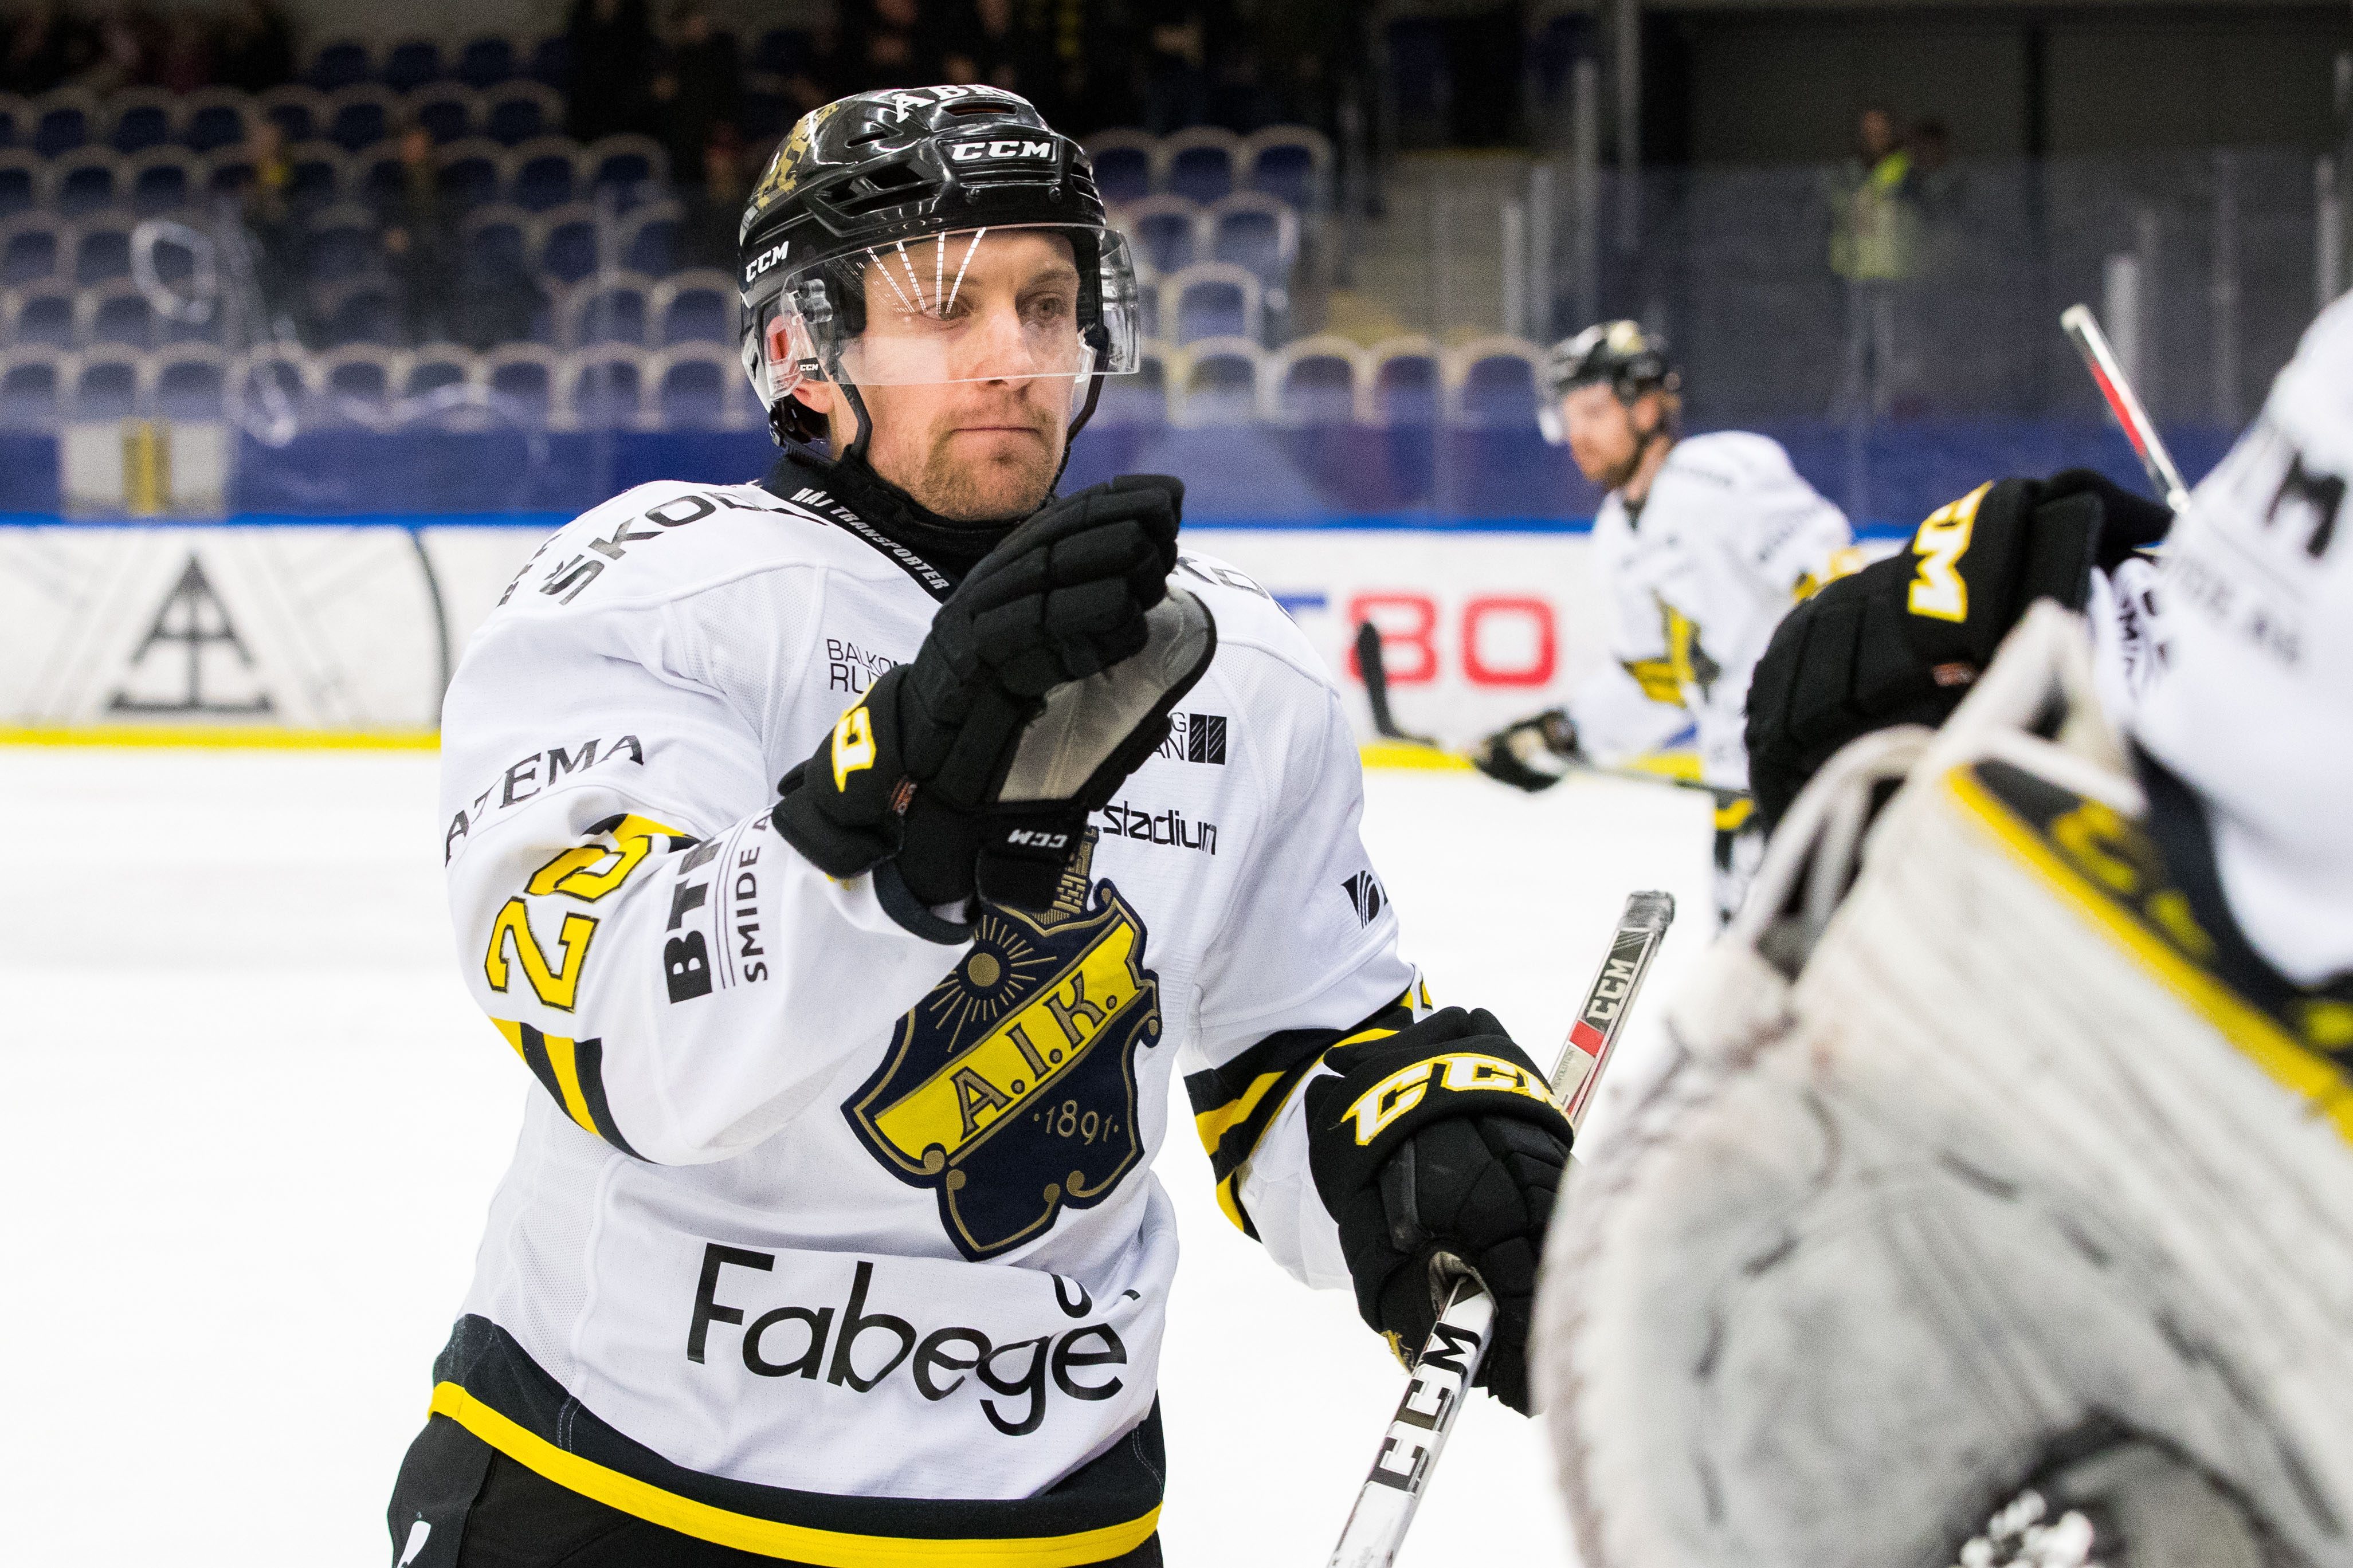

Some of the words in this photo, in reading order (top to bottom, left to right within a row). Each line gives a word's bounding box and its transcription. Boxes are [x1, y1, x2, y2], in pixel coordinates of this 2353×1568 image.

[951, 141, 1050, 161] CCM
[746, 241, 789, 282] CCM
[800, 363, 818, 371] CCM
[790, 488, 834, 507] HÅJ
[830, 506, 950, 590] TRANSPORTER
[826, 638, 898, 677] BALKO
[1007, 828, 1068, 848] CCM
[734, 846, 768, 982] SMIDE
[1586, 958, 1636, 1020] CCM
[950, 970, 1117, 1142] A.I.K.
[688, 1242, 1127, 1436] Fabege
[1366, 1321, 1482, 1495] CCM
